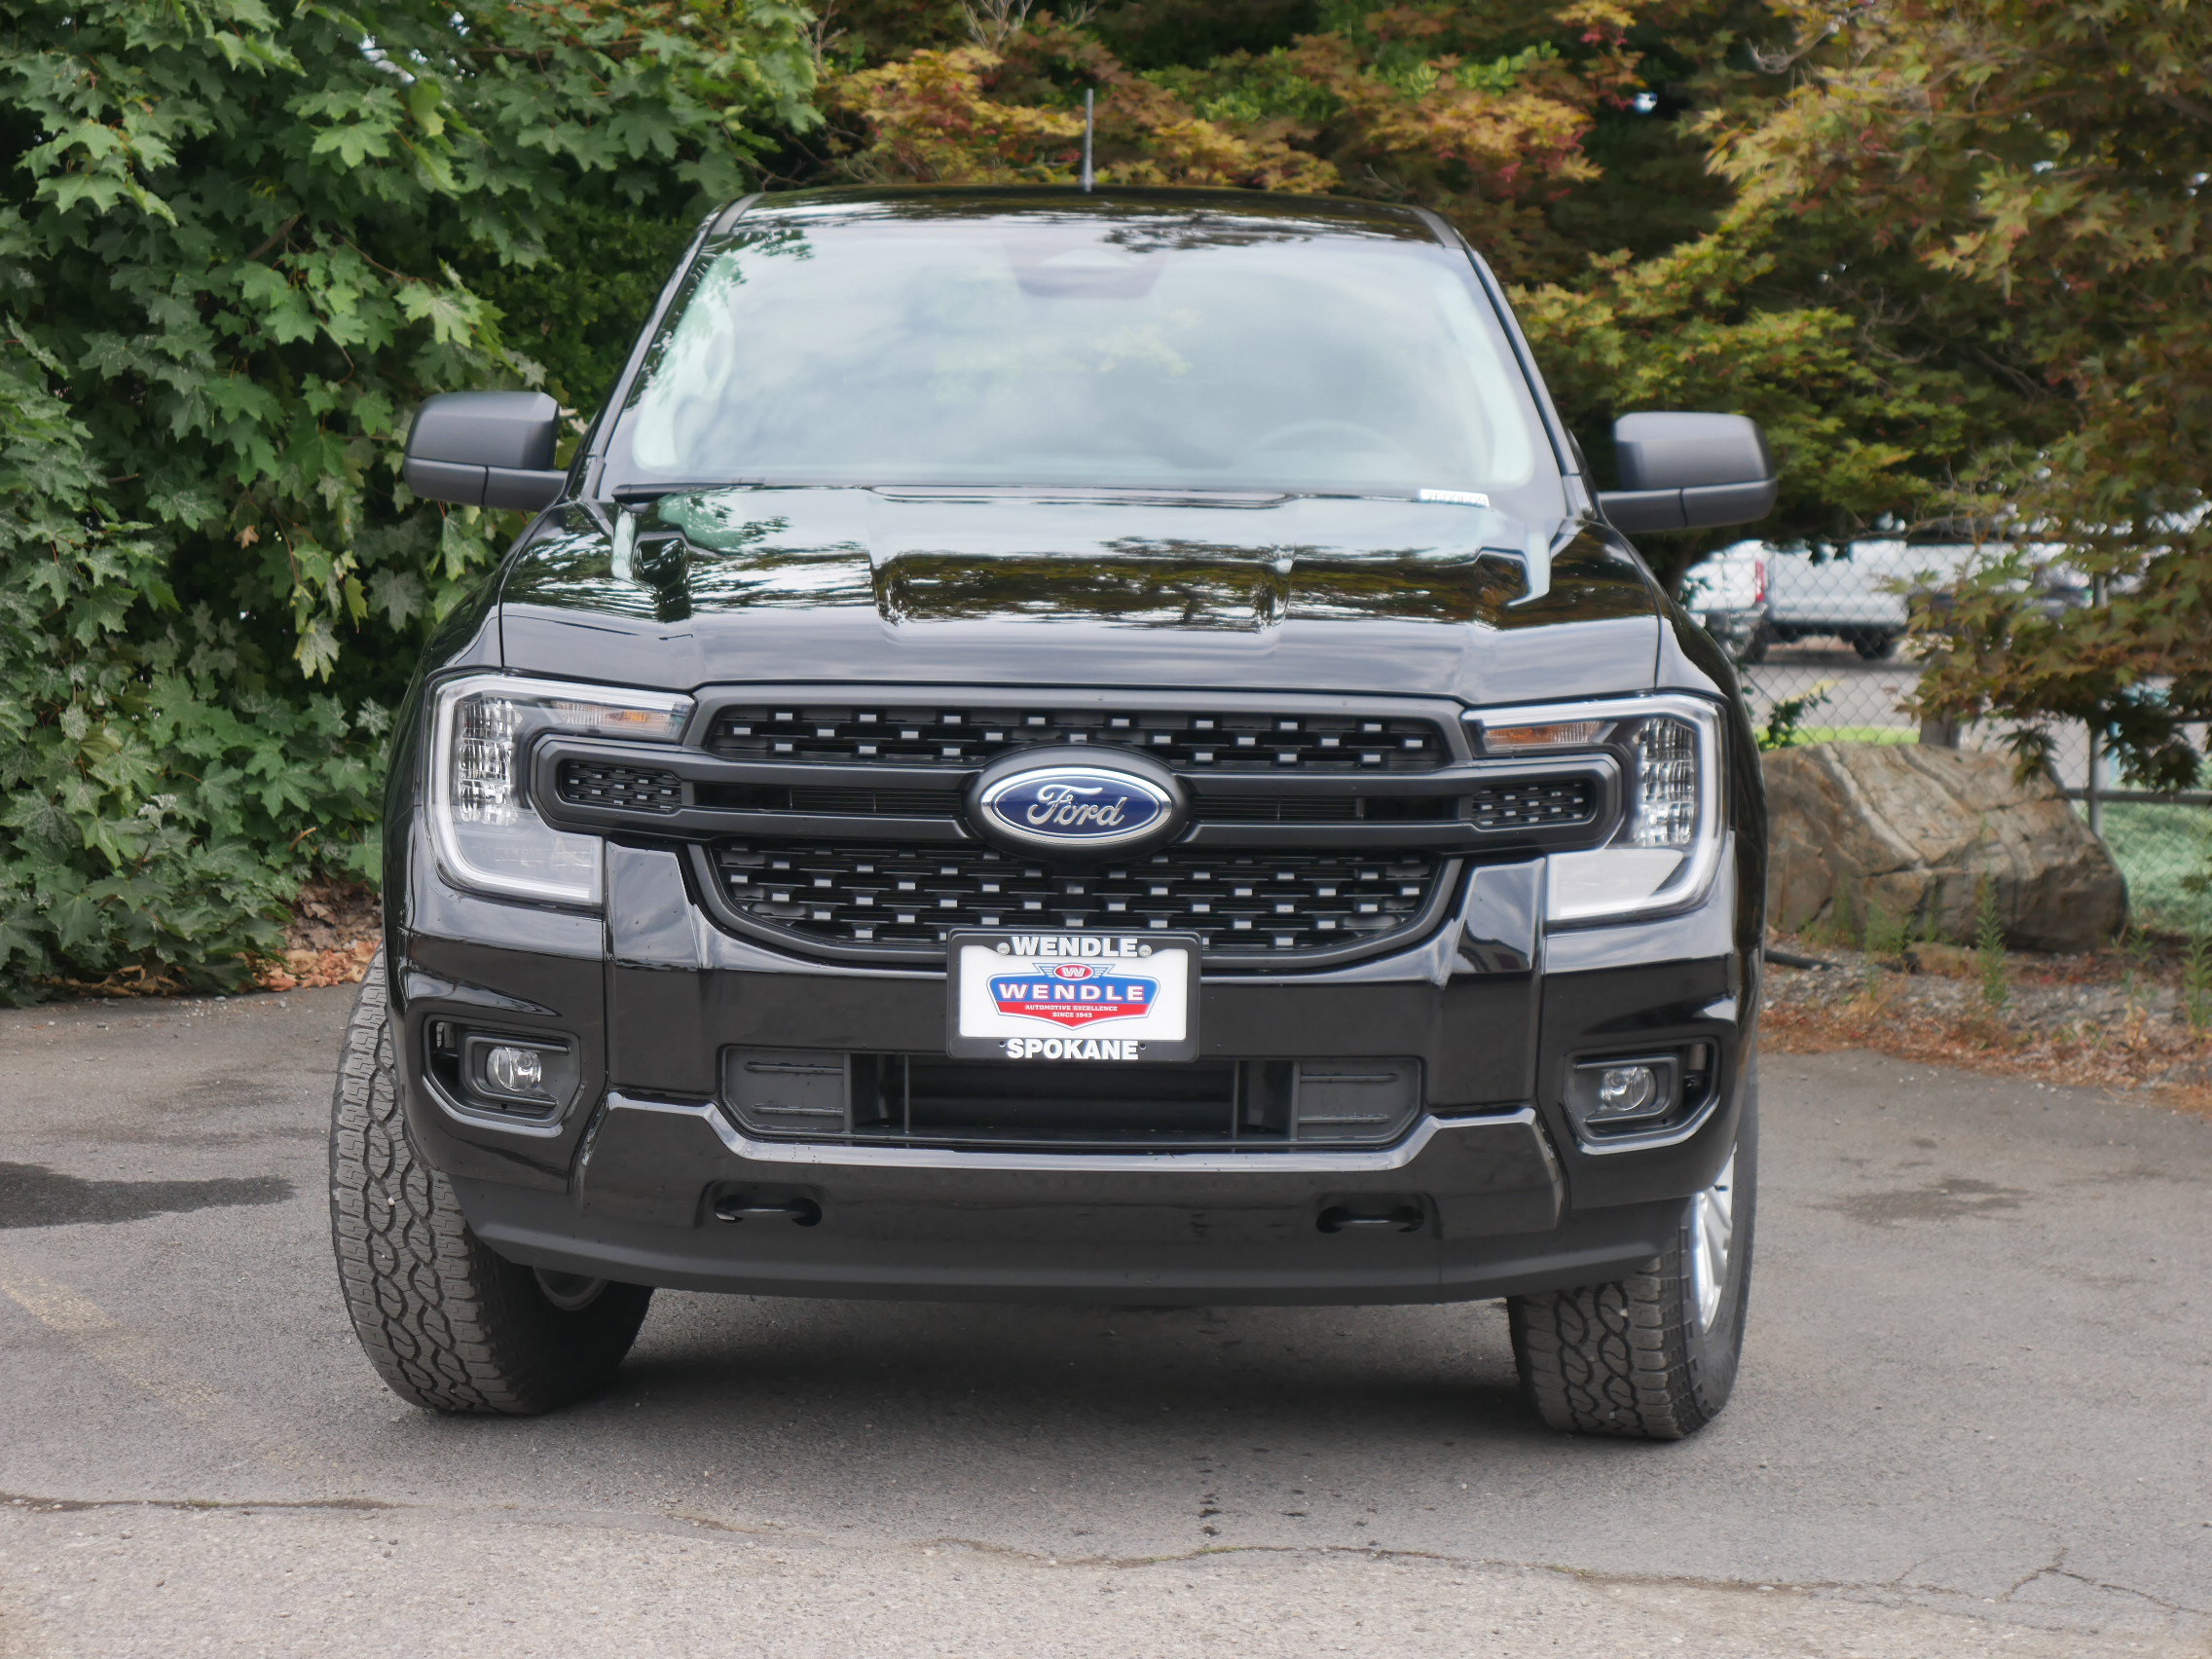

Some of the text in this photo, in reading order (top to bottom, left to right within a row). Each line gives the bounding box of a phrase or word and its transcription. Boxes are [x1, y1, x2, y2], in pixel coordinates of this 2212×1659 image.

[1026, 784, 1128, 827] Ford
[1012, 936, 1138, 958] WENDLE
[998, 982, 1145, 1001] WENDLE
[1006, 1038, 1139, 1060] SPOKANE
